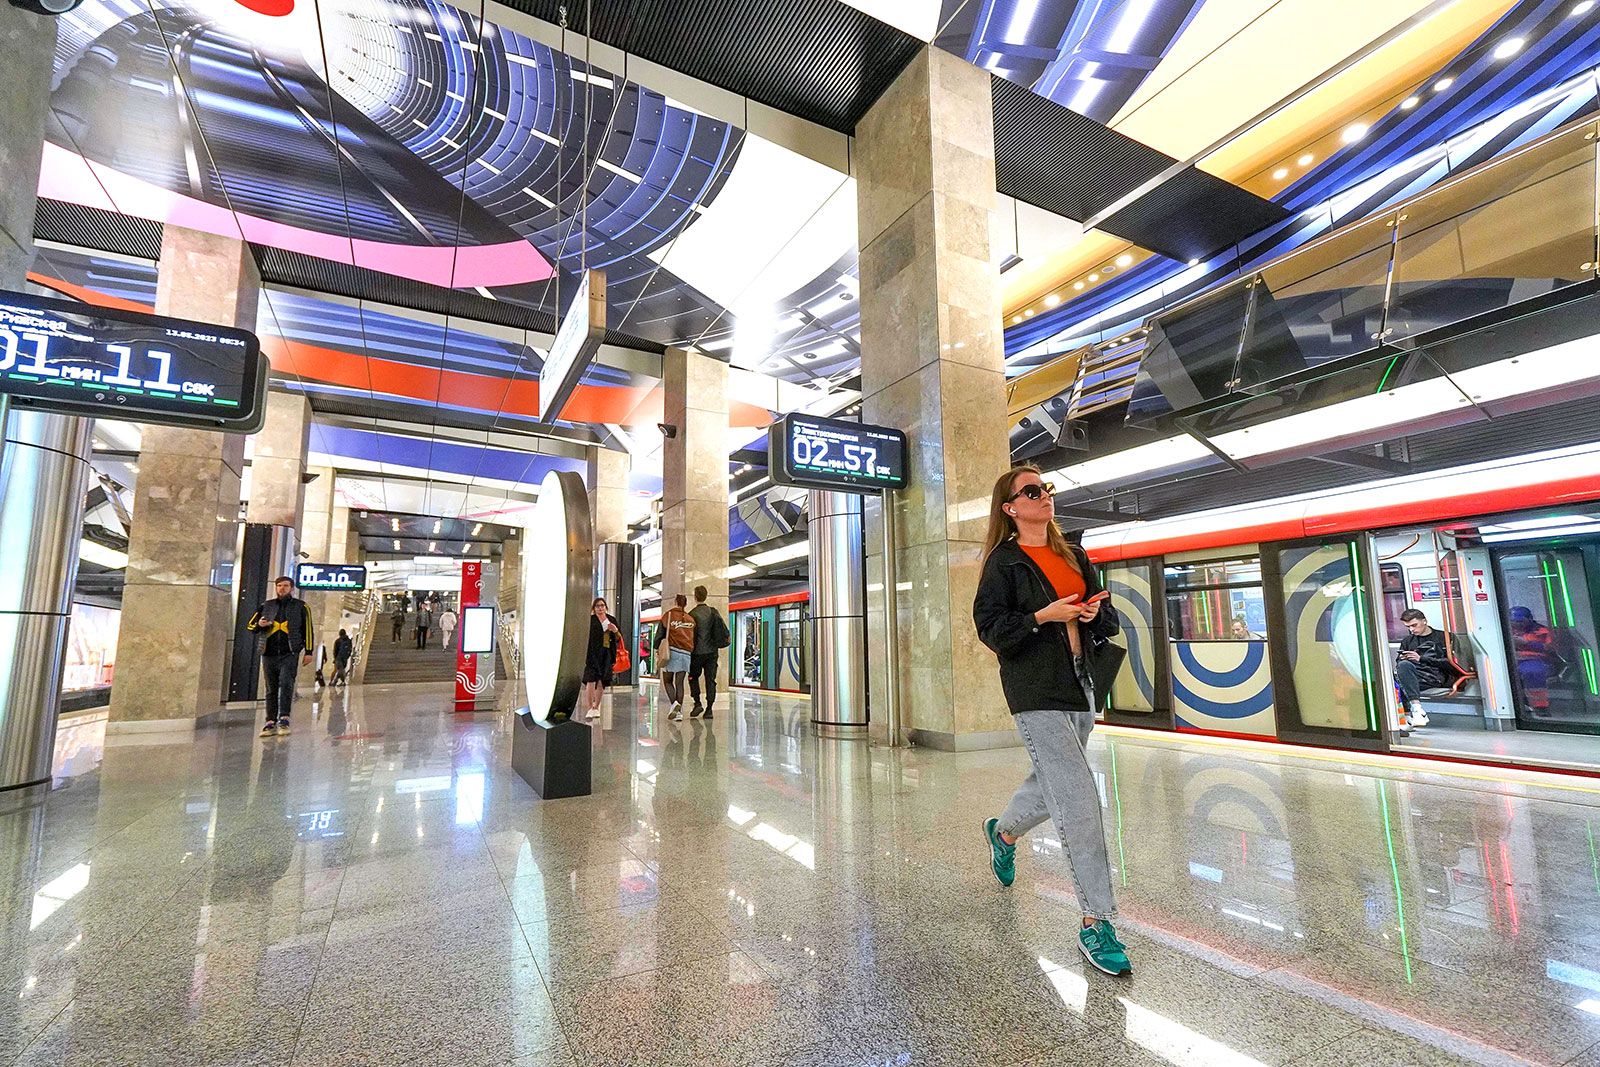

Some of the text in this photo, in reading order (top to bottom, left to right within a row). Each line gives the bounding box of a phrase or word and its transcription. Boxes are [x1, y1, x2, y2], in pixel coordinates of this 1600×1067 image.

[102, 344, 181, 392] 11
[793, 437, 829, 467] 02
[844, 443, 877, 478] 57
[1085, 935, 1100, 951] N
